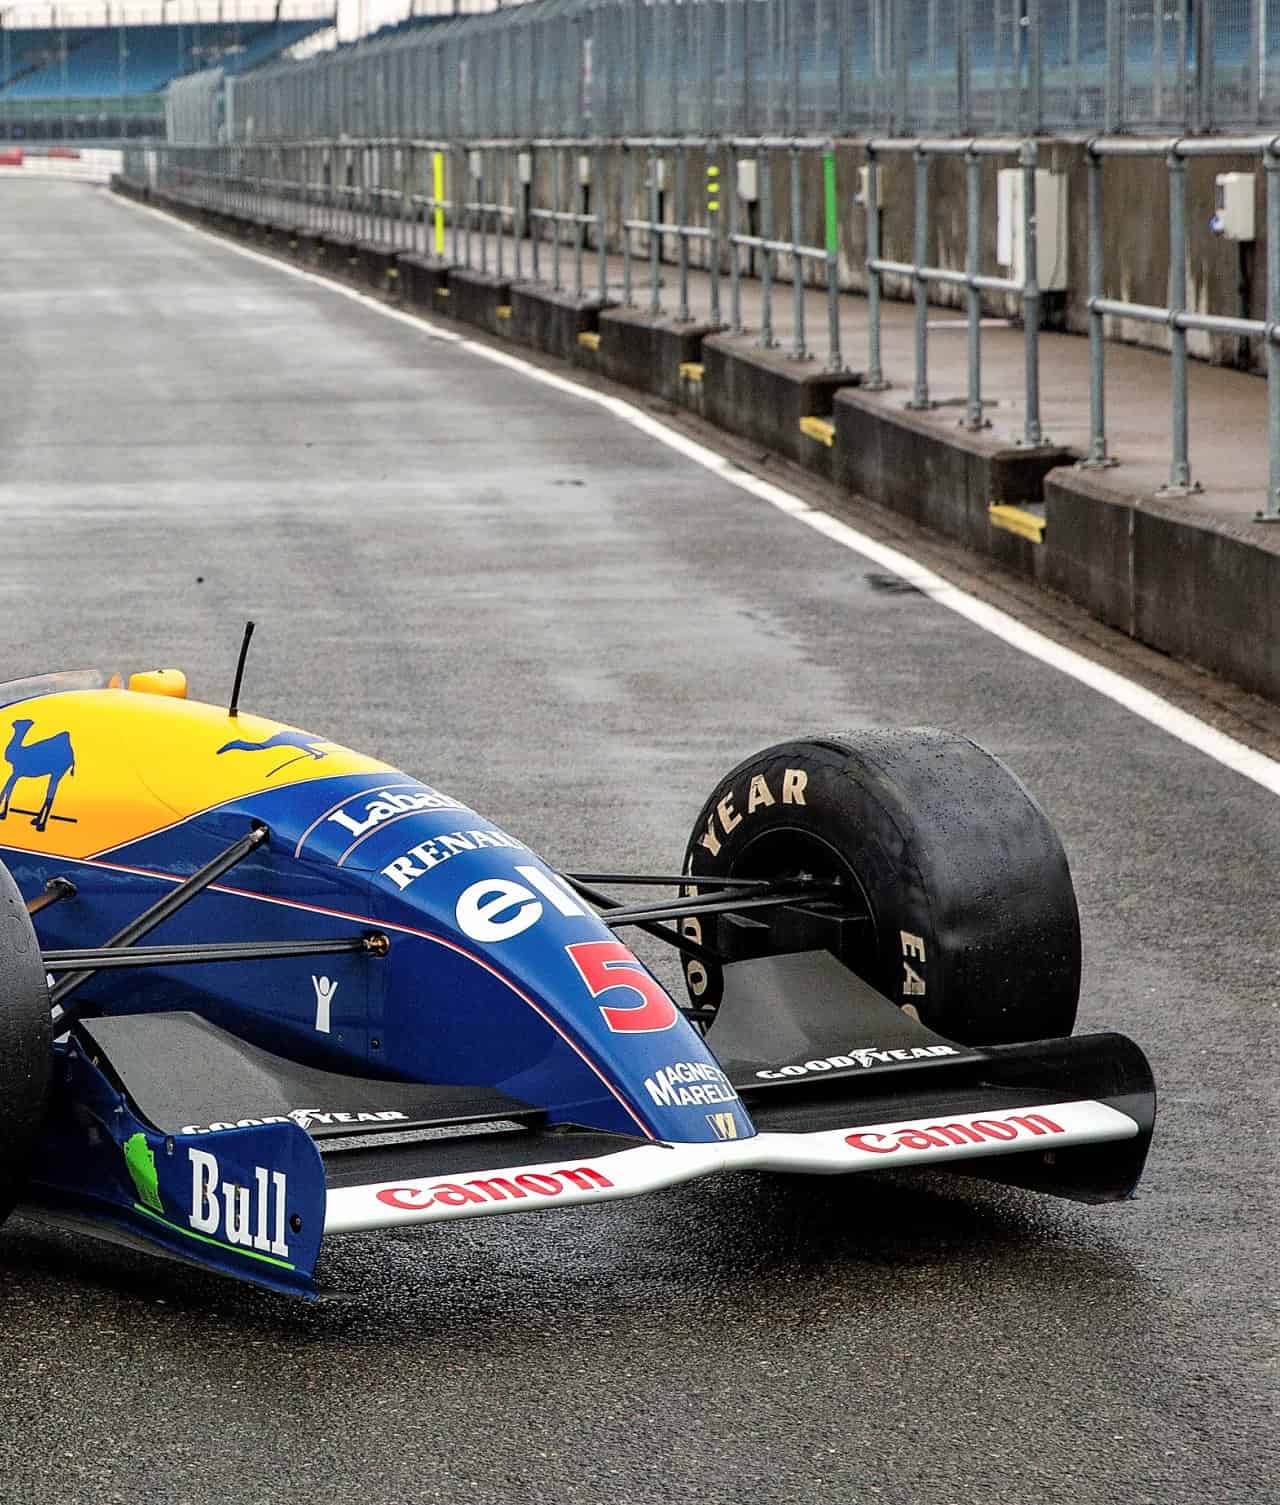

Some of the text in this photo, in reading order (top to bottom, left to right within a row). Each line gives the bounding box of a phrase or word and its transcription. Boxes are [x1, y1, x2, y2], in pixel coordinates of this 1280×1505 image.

[454, 865, 592, 943] el
[564, 940, 679, 1034] 5
[843, 1112, 1065, 1154] Canon
[187, 1147, 289, 1258] Bull
[375, 1166, 615, 1211] Canon
